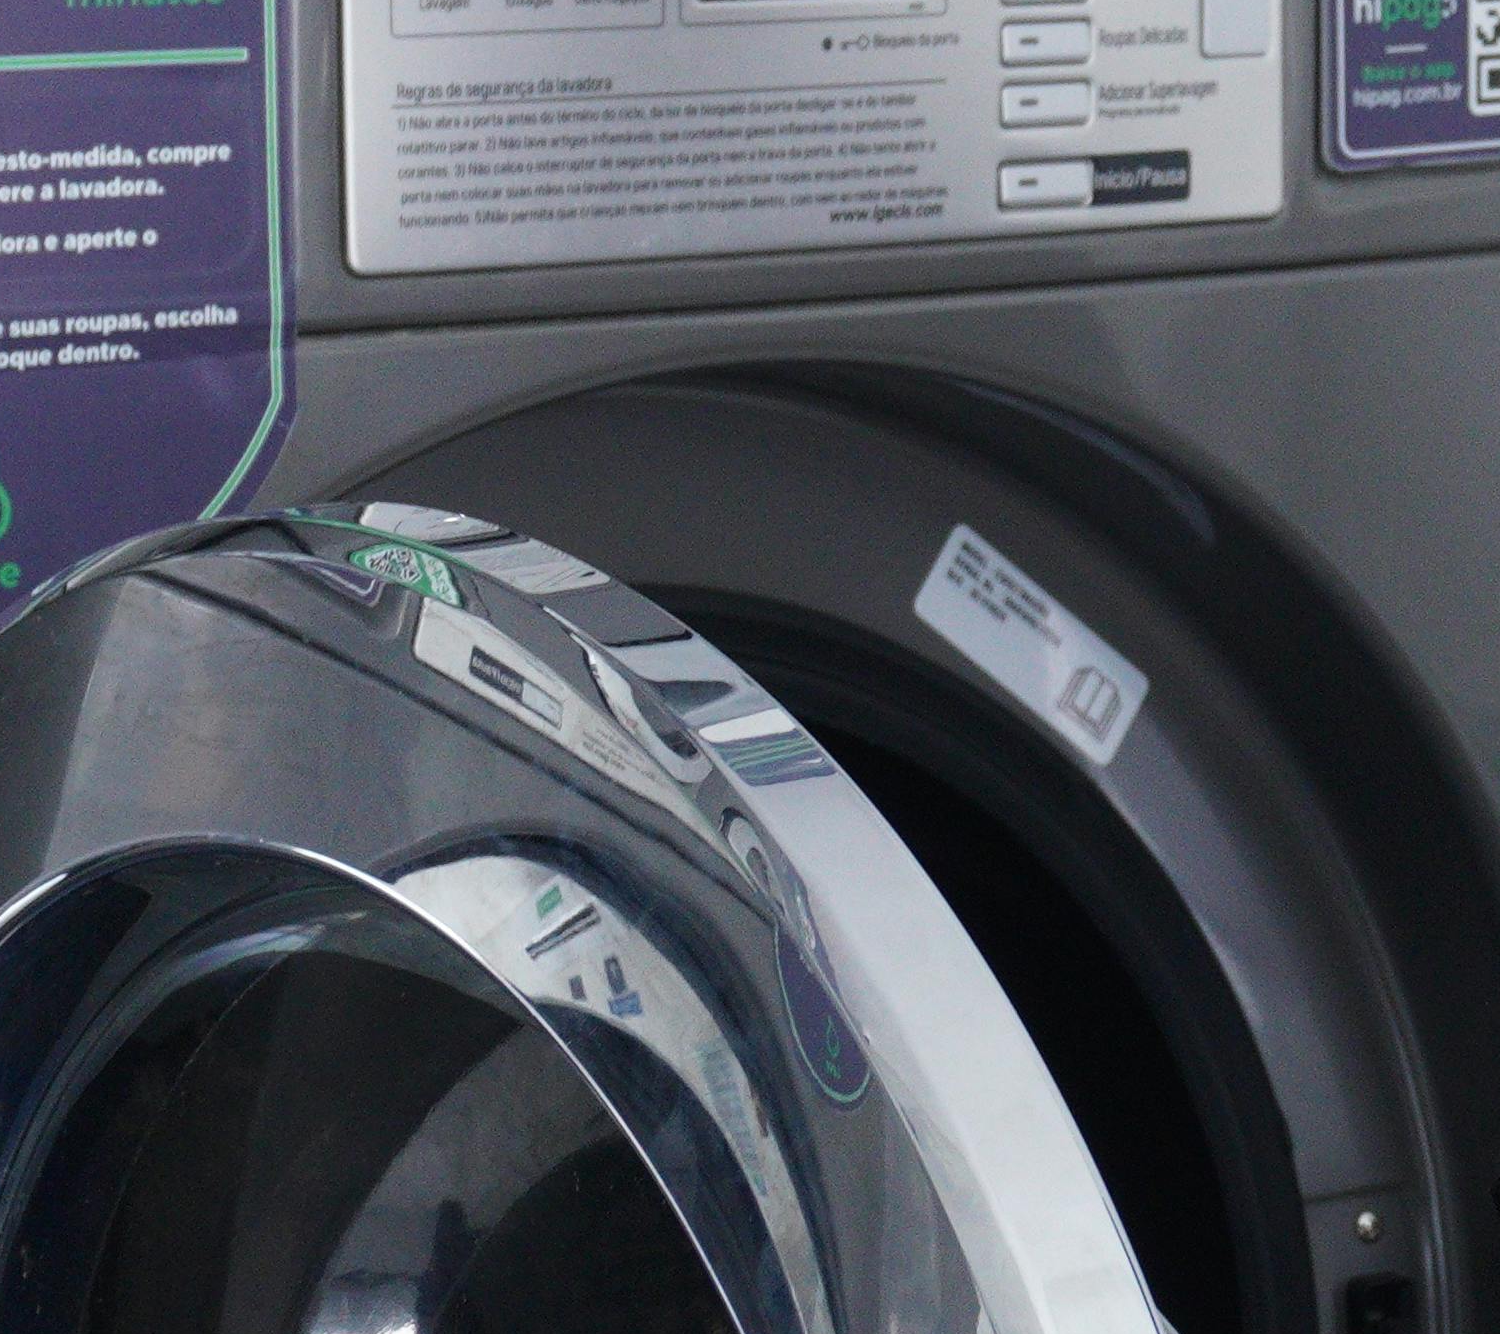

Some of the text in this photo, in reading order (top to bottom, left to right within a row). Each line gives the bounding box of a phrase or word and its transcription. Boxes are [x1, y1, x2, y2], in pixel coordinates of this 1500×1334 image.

[147, 145, 231, 166] compre
[40, 184, 54, 200] a
[44, 235, 58, 251] e
[64, 228, 137, 253] aperte
[142, 230, 157, 246] o
[9, 318, 60, 337] suas
[154, 306, 238, 328] escolha
